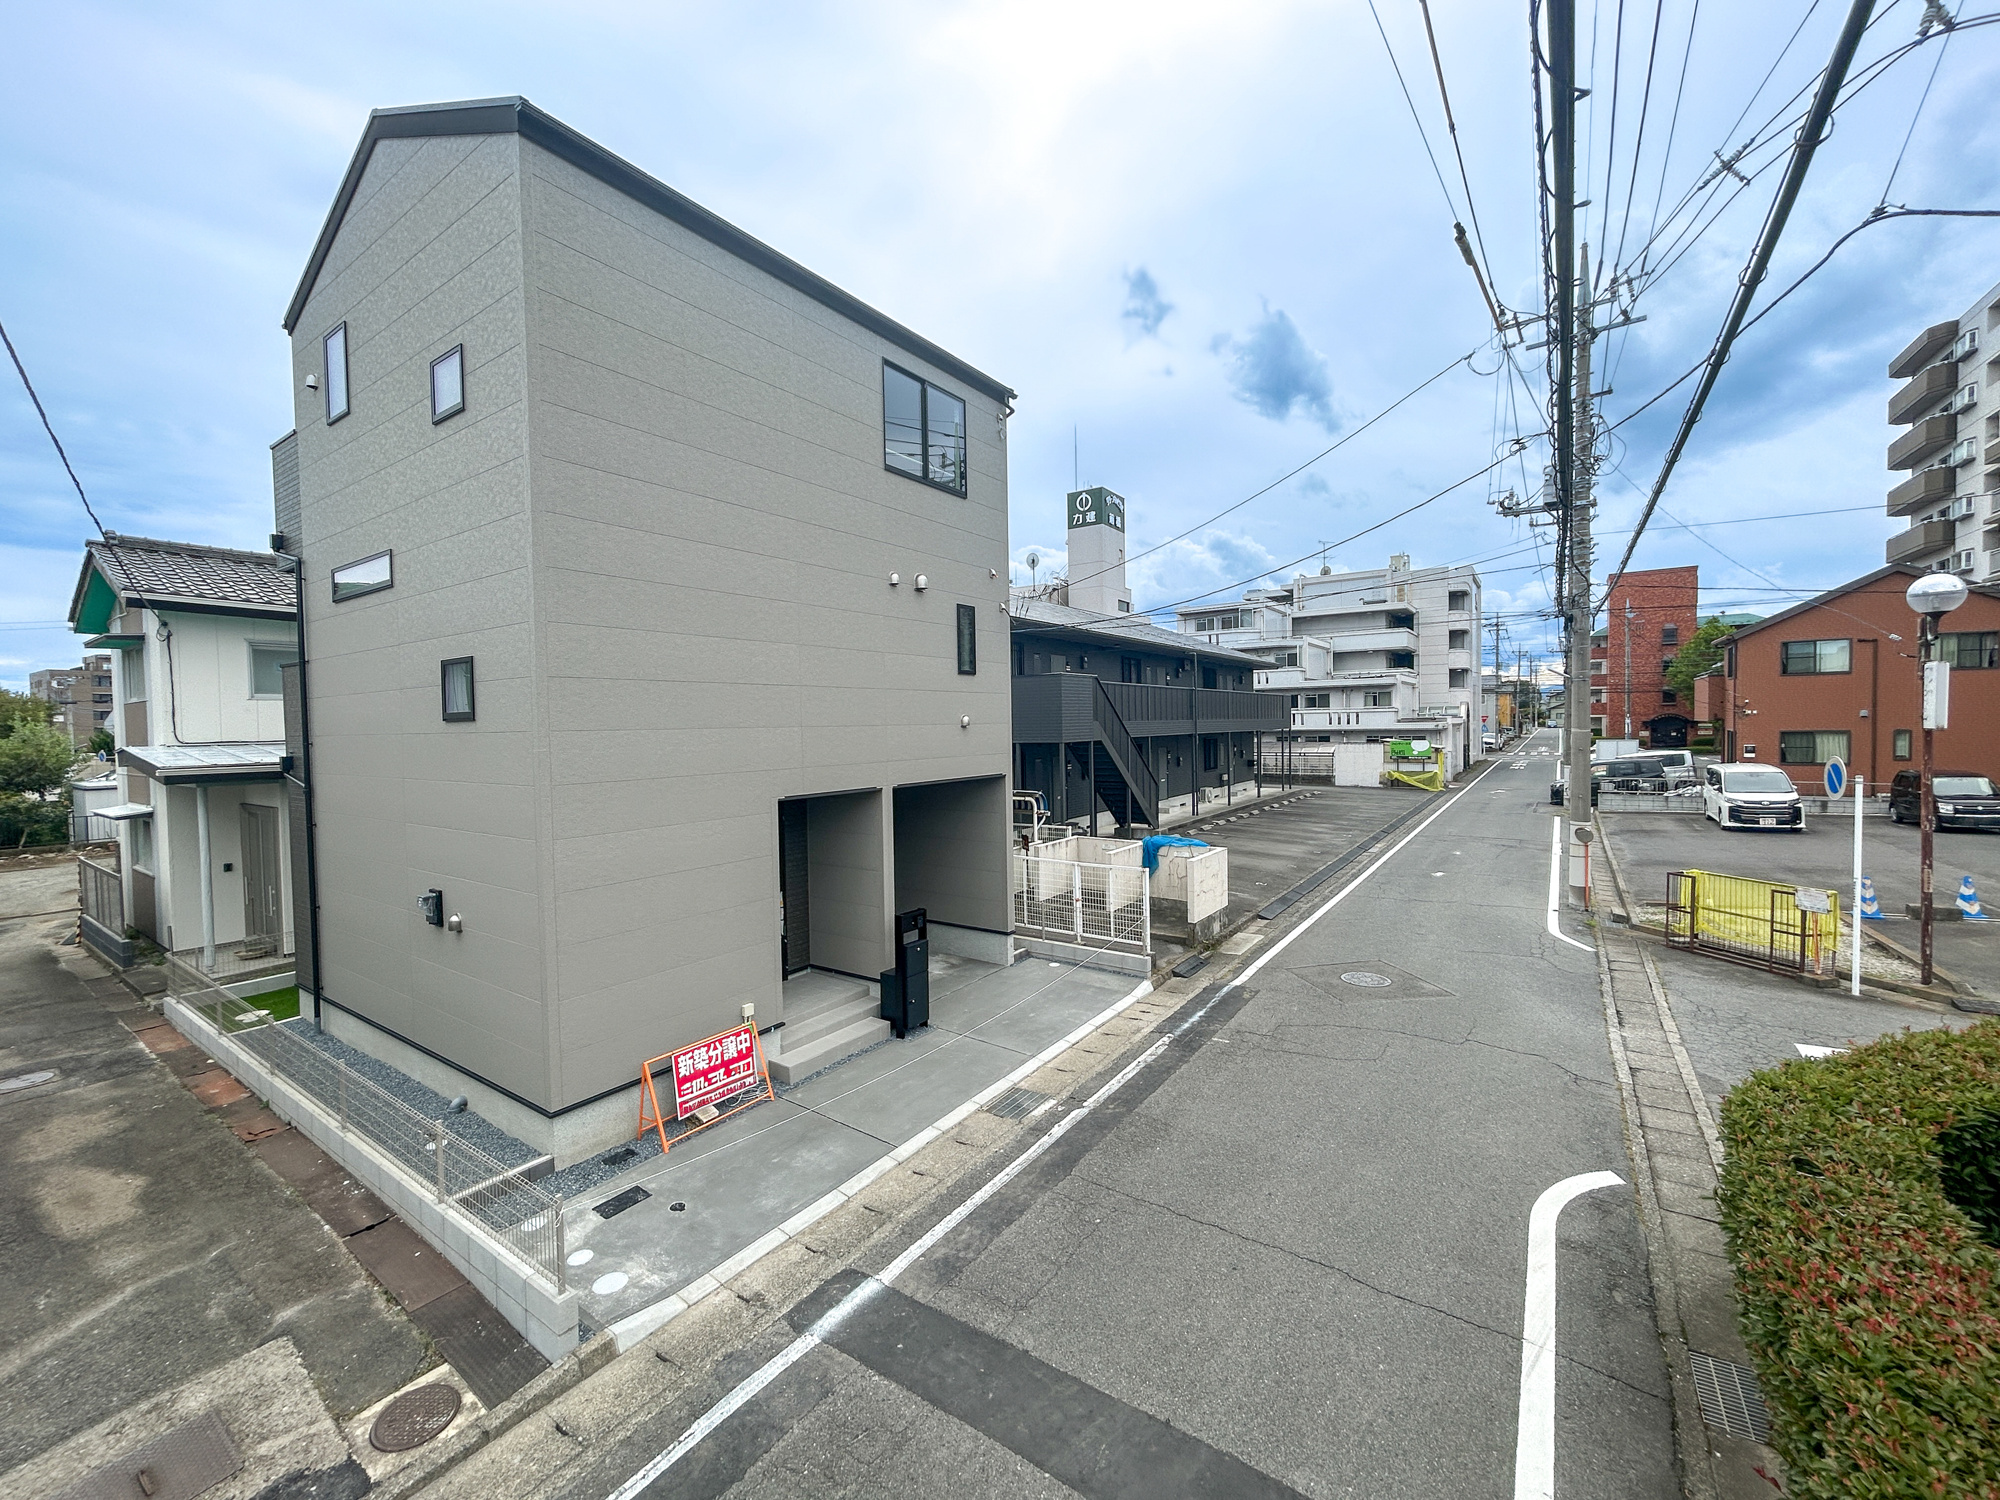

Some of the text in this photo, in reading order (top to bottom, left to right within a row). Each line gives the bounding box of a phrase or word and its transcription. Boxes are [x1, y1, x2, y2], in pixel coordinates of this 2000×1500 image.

[677, 1031, 751, 1078] 新築分譲中
